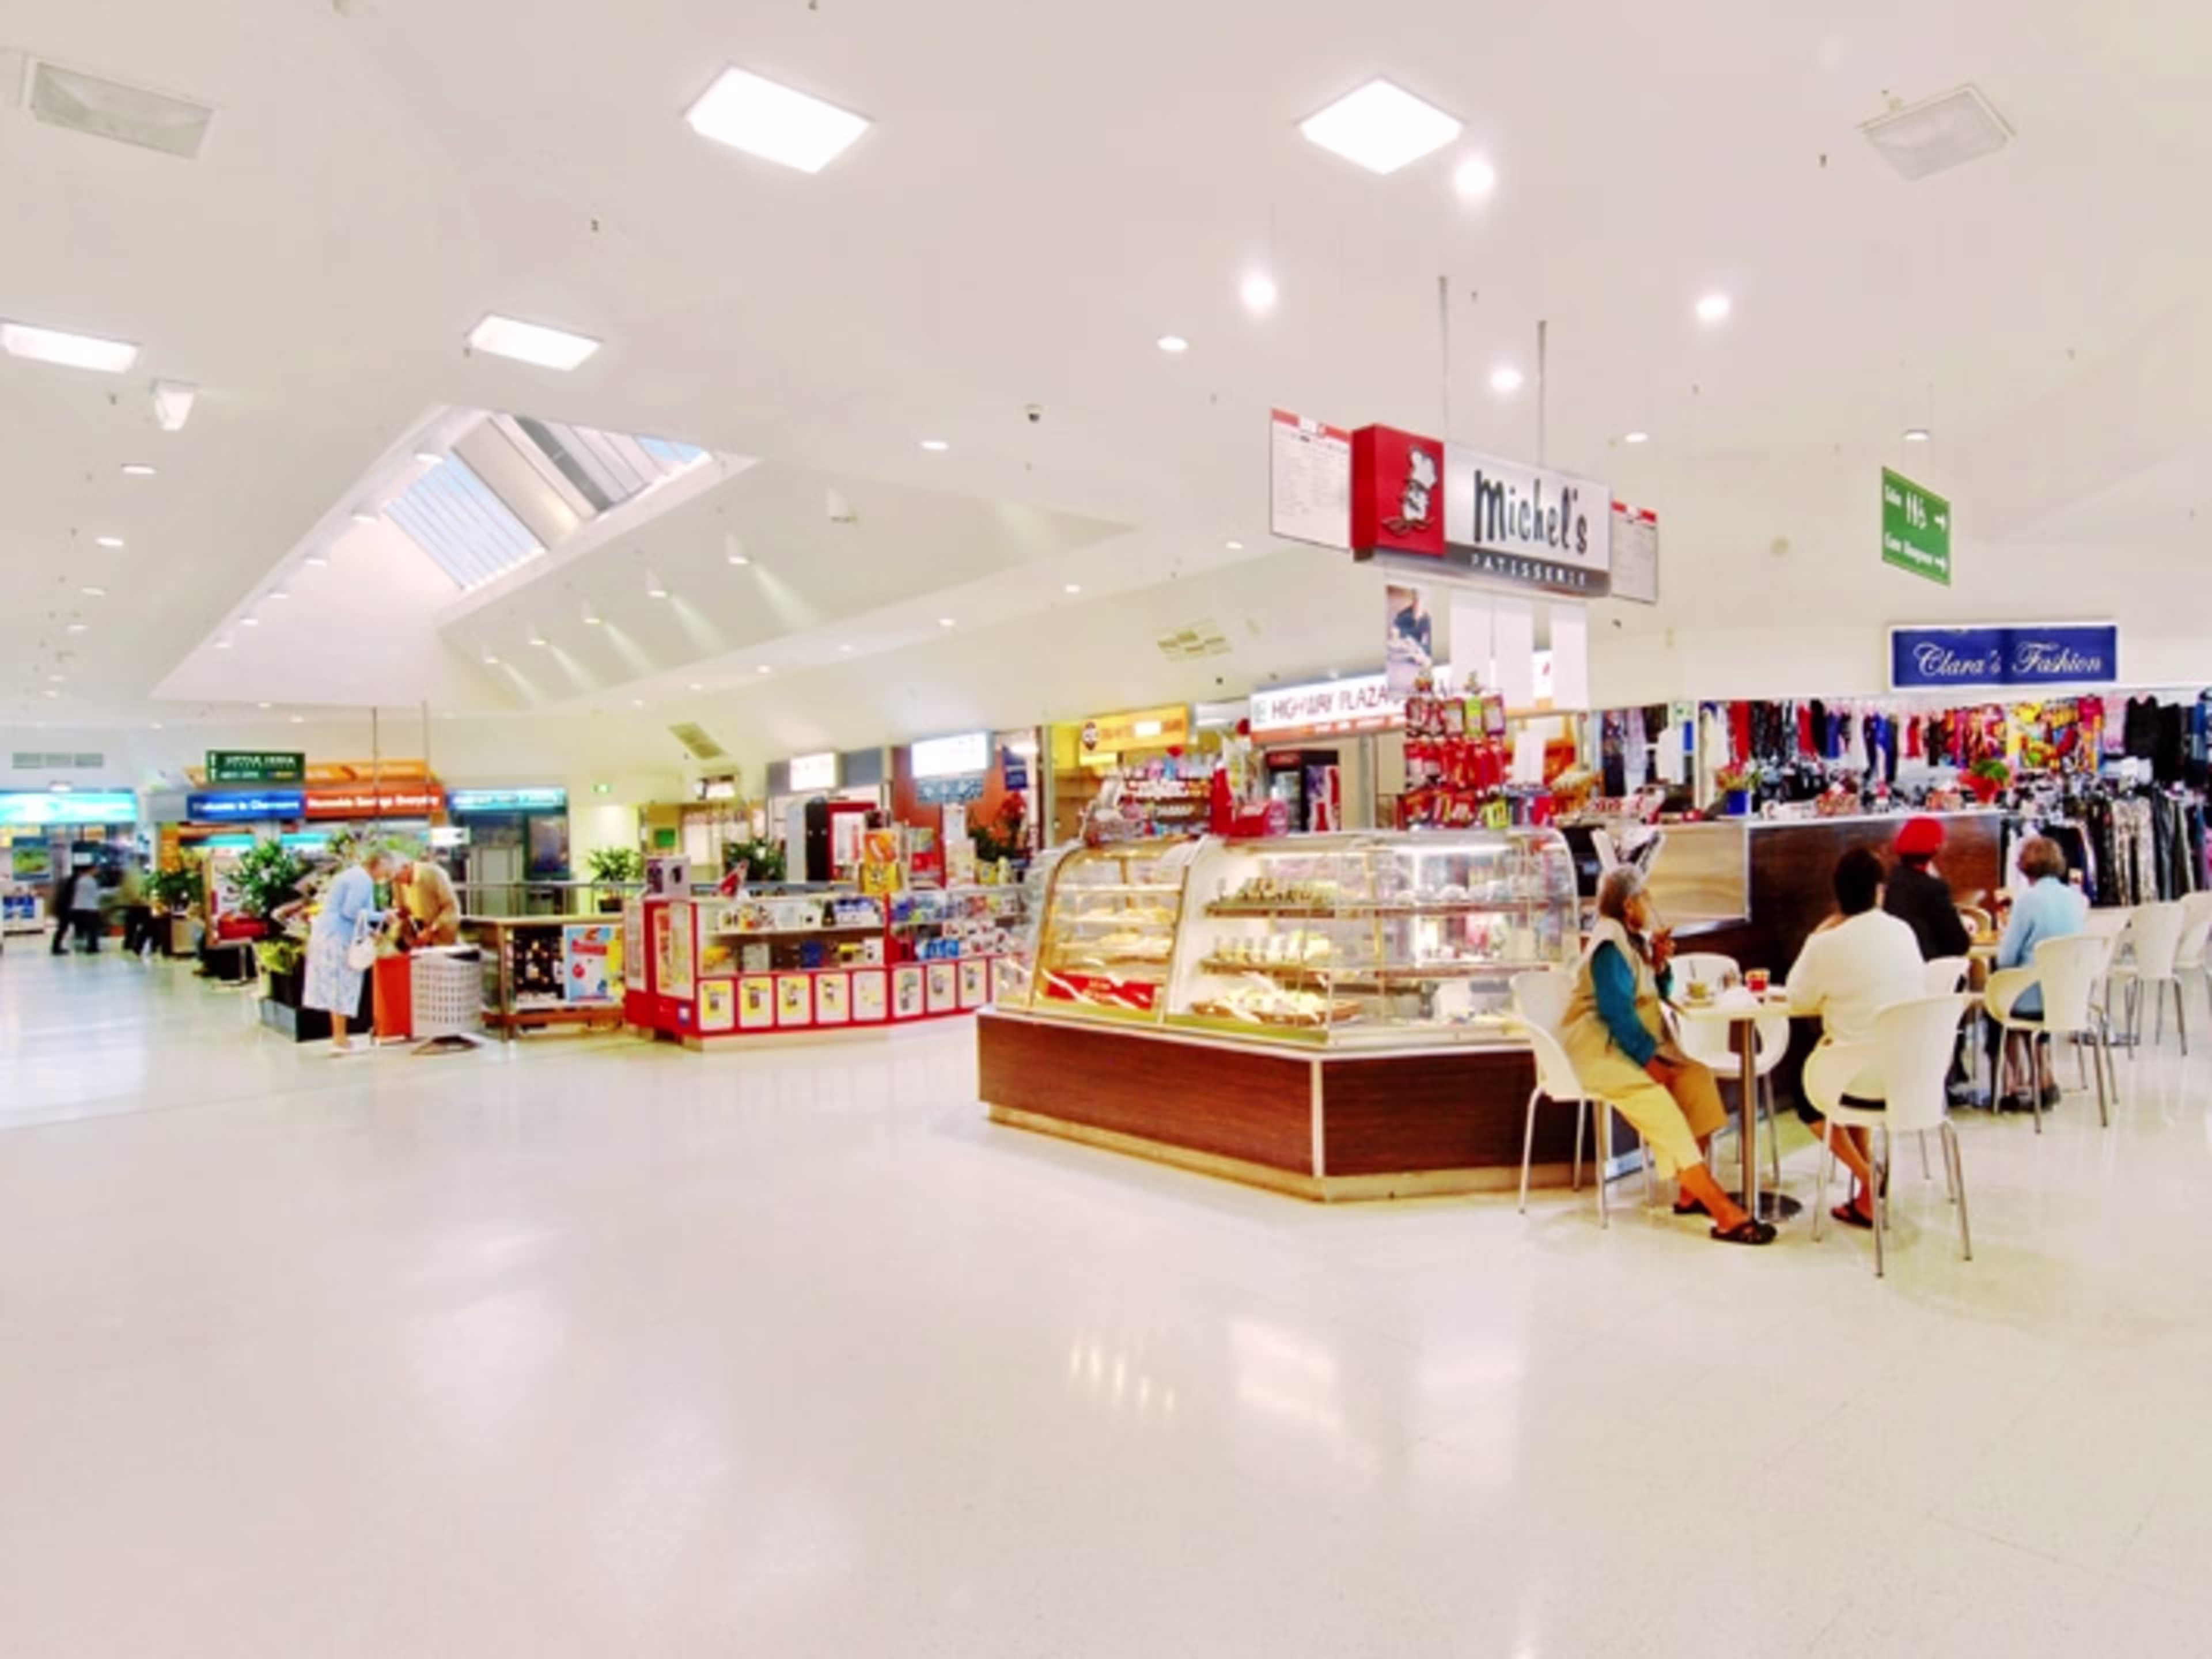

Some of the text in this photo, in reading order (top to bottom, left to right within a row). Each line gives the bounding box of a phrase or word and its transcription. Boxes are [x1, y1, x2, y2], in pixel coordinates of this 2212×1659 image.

[1474, 469, 1587, 554] Michel's
[1472, 553, 1585, 586] PATISSERIE
[1913, 641, 2101, 676] Clara's Fashion
[1271, 693, 1334, 719] HIGHWAY
[1339, 685, 1388, 710] PLAZA
